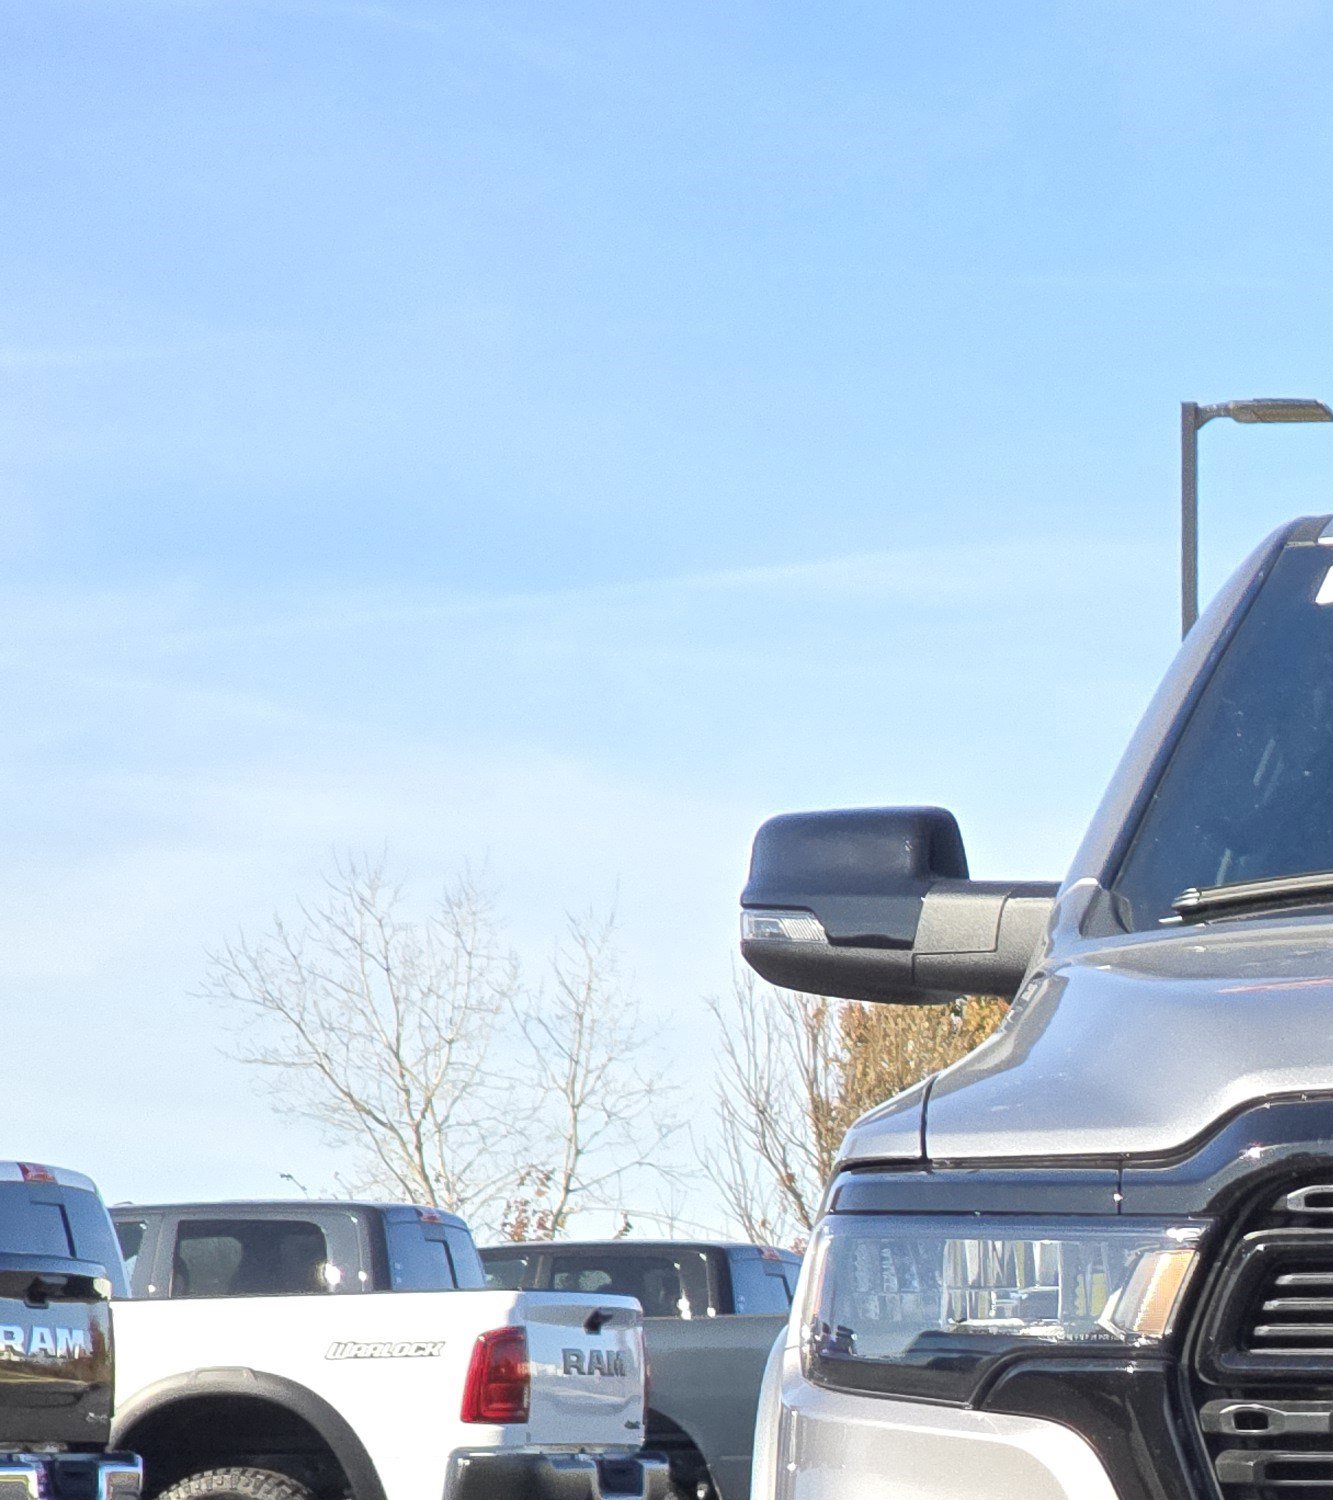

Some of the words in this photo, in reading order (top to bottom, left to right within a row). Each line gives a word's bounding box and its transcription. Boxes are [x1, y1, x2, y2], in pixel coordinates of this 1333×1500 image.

[0, 1325, 87, 1360] RAM
[325, 1341, 446, 1360] WARLOCK
[562, 1348, 626, 1377] RAM
